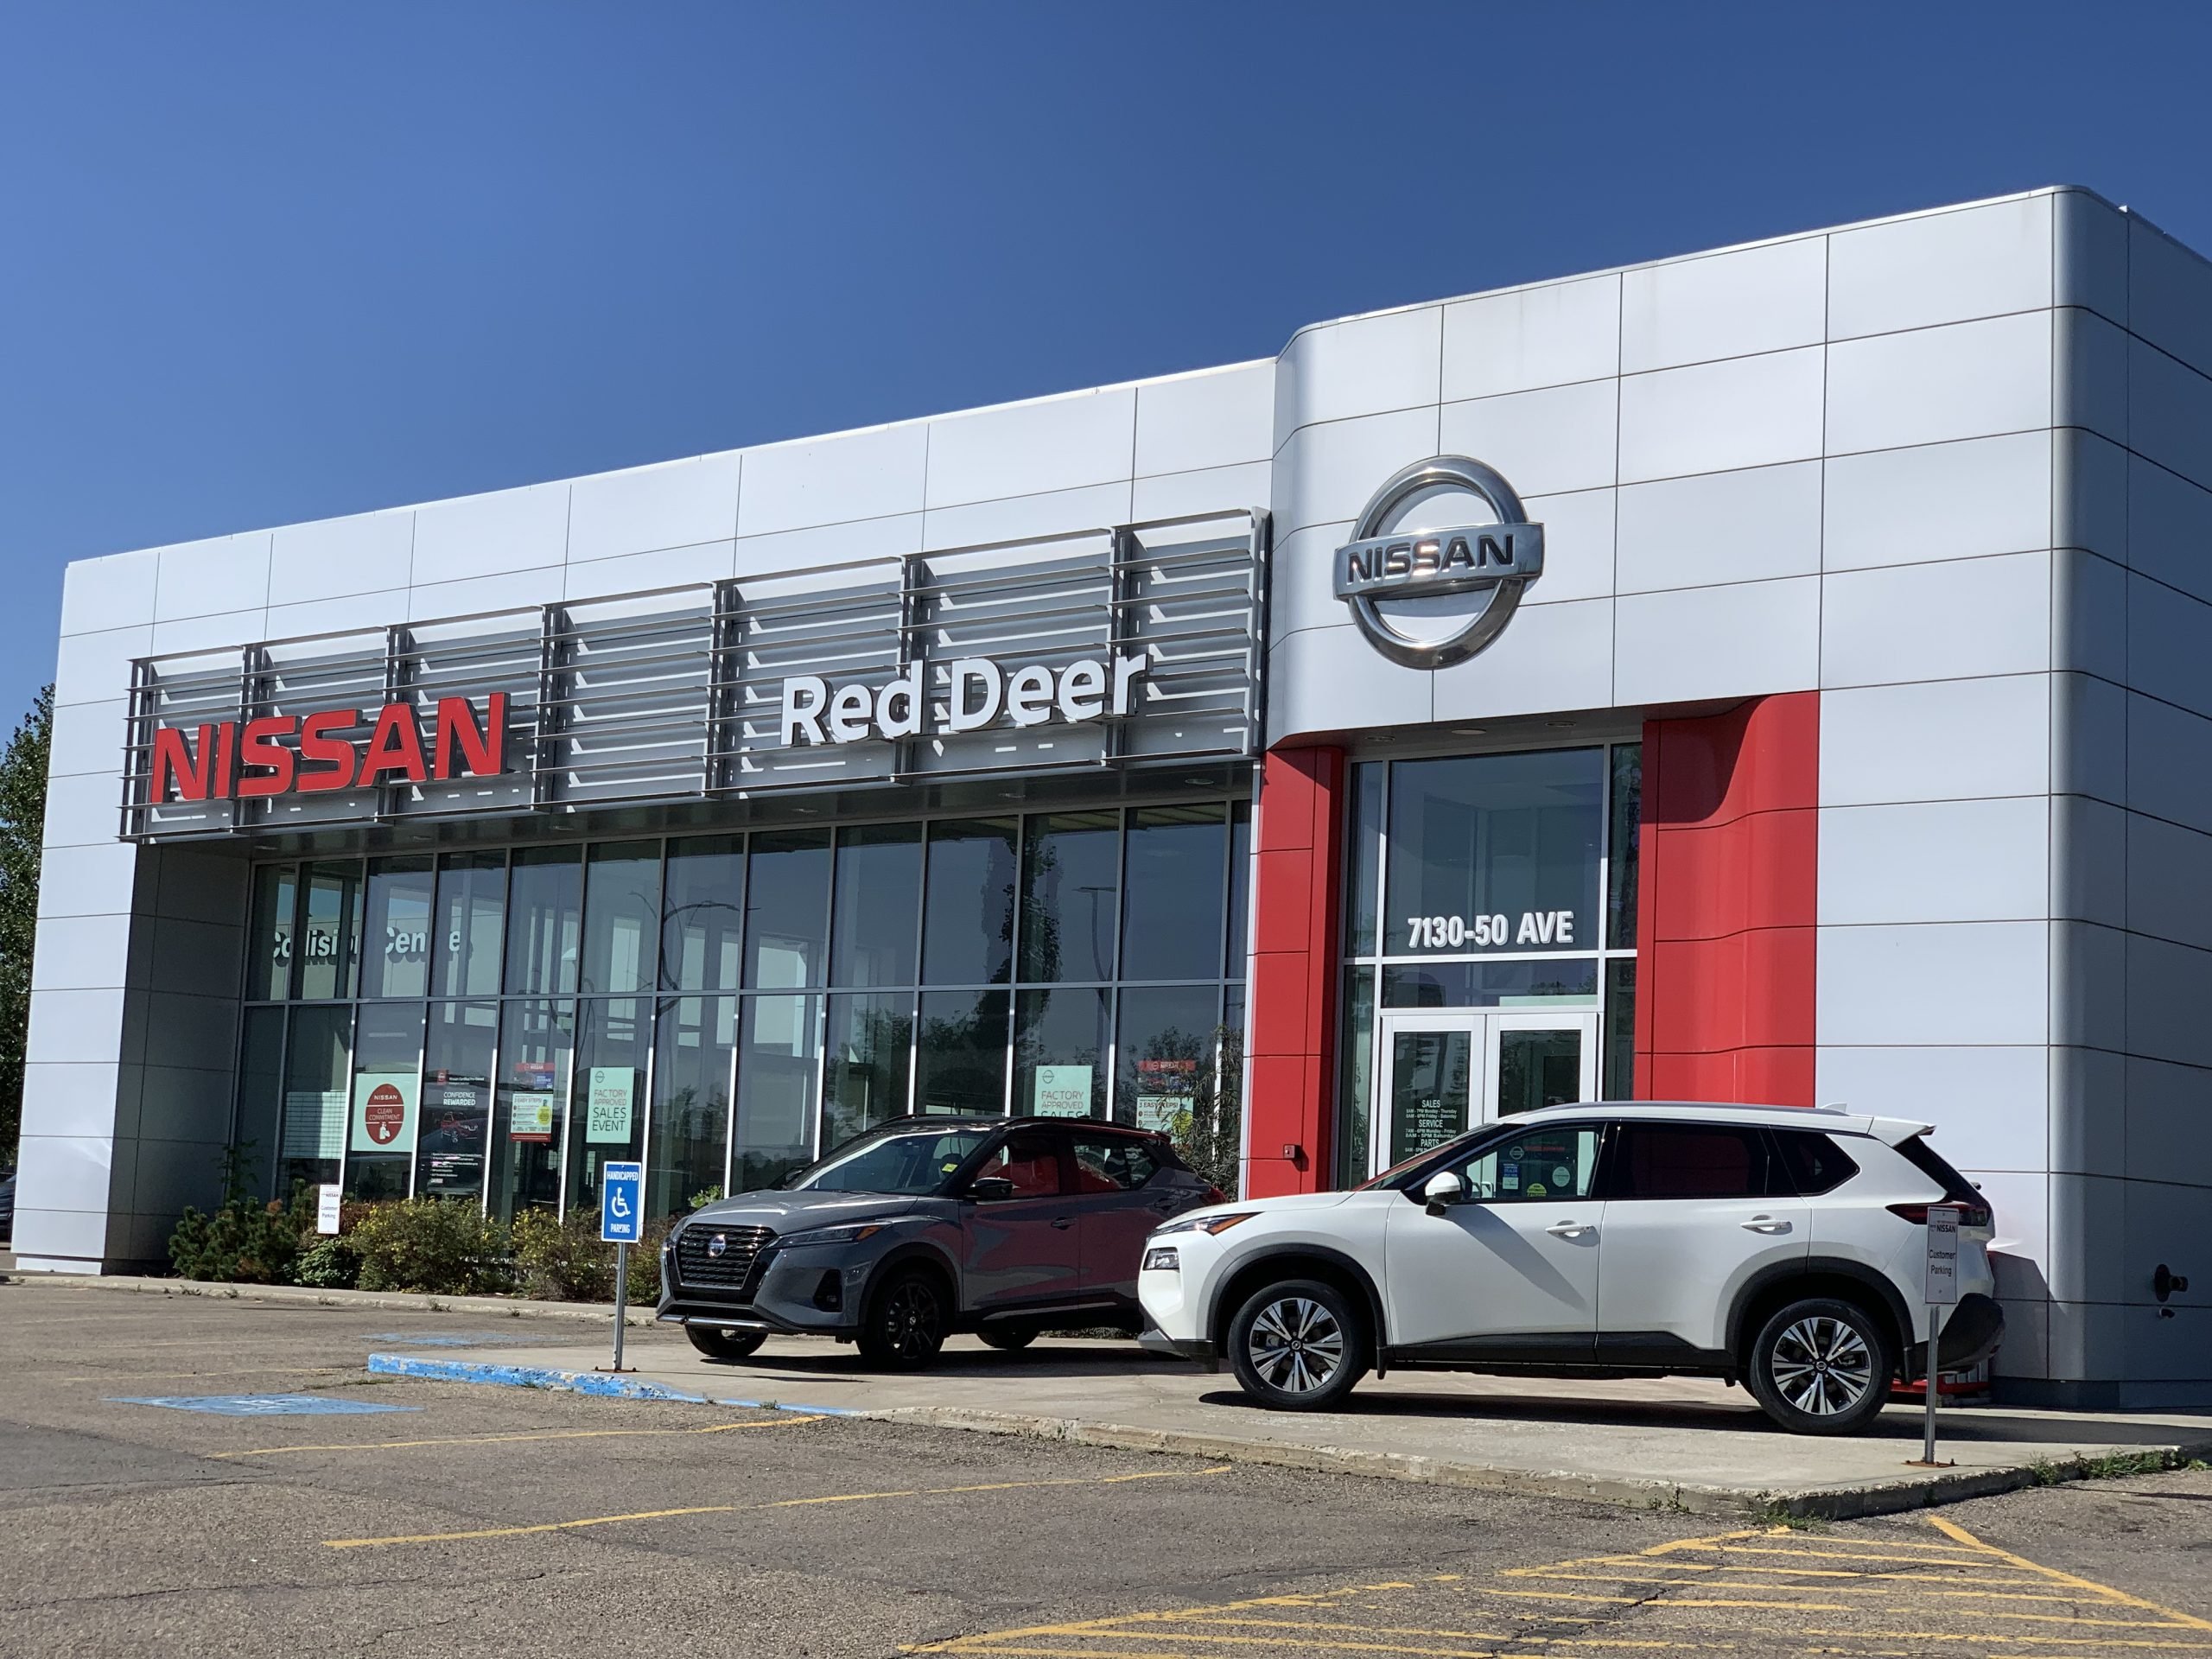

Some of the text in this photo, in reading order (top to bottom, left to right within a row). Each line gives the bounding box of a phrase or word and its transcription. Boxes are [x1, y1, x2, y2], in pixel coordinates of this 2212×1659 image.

[1347, 533, 1515, 586] NISSAN
[780, 653, 1154, 746] Red Deer
[151, 692, 510, 804] NISSAN
[1408, 911, 1574, 949] 7130-50 AVE
[594, 1089, 627, 1097] FACTORY
[1041, 1090, 1084, 1100] FACTORY
[1041, 1101, 1084, 1109] APPROVED
[1421, 1099, 1441, 1108] SALES
[593, 1107, 626, 1119] SALES
[592, 1120, 626, 1131] EVENT
[1418, 1119, 1443, 1128] SERVICE
[1421, 1139, 1440, 1147] PARTS
[607, 1171, 639, 1181] HANDICAPPED
[610, 1223, 631, 1234] PARKING
[1936, 1224, 1956, 1233] NISSAN
[1929, 1249, 1956, 1260] Customer
[1930, 1264, 1952, 1277] Parking
